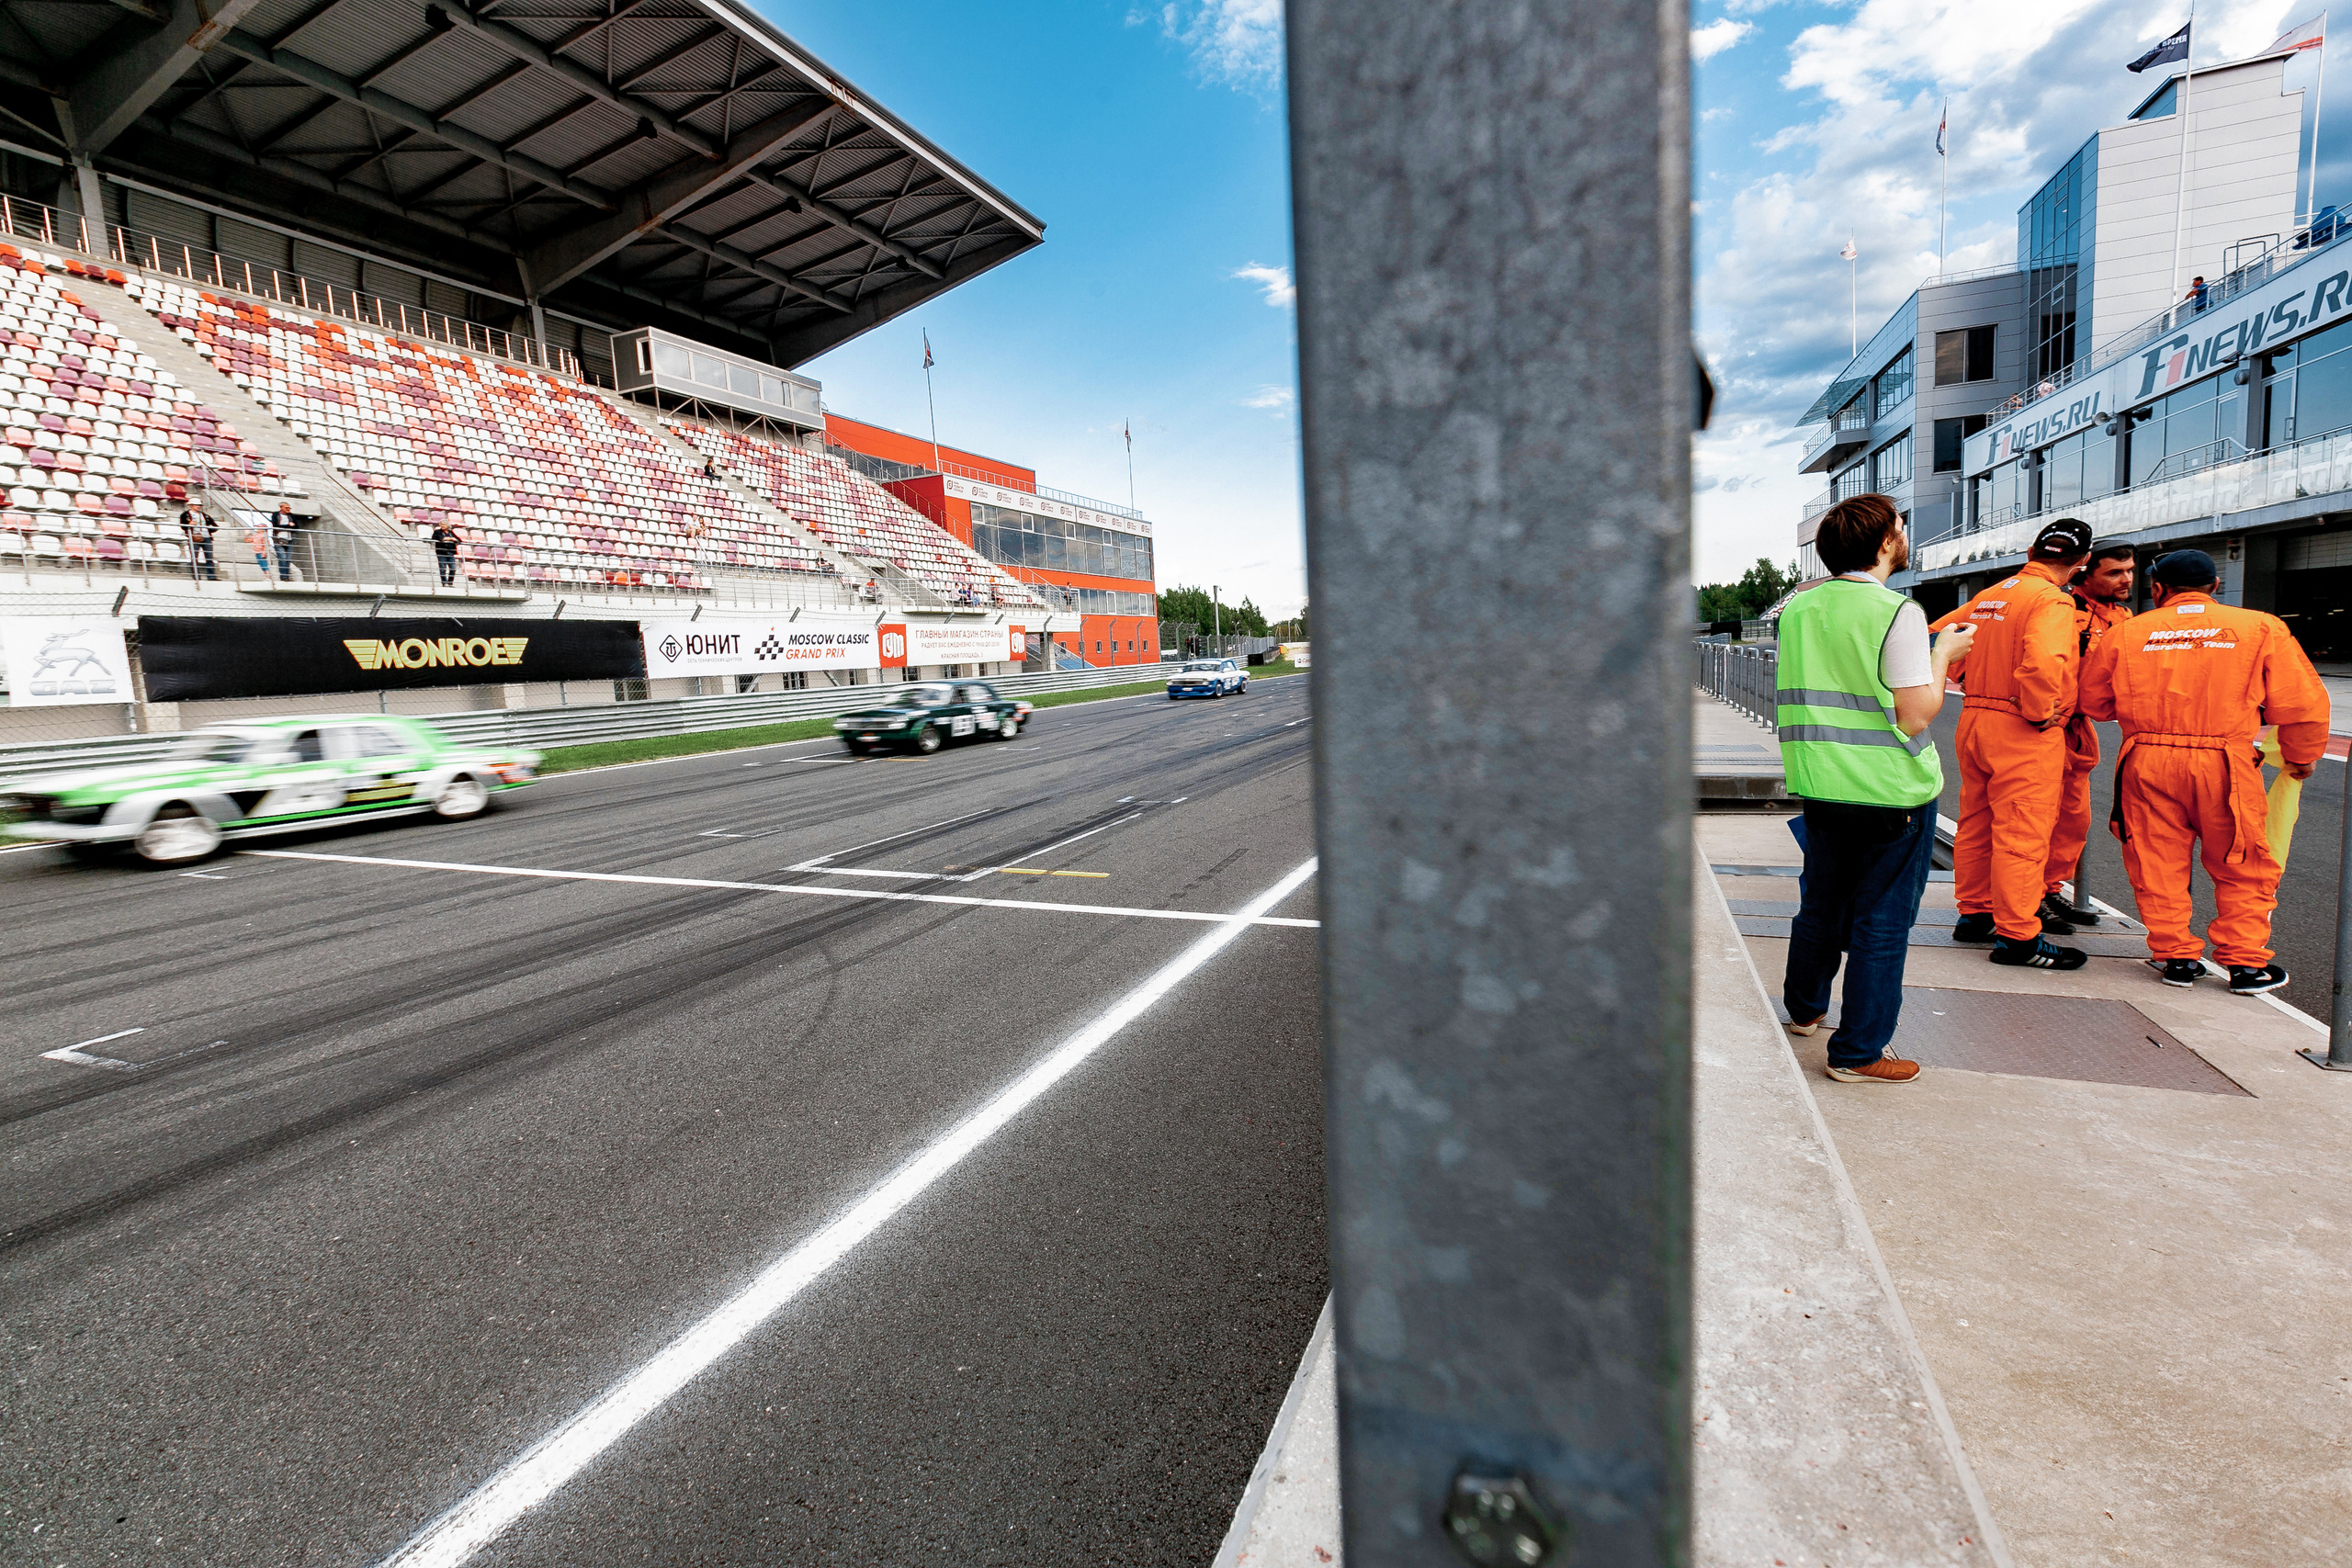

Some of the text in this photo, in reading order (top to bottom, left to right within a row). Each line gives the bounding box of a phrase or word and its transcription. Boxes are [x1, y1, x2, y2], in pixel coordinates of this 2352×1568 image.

[2134, 270, 2352, 400] F1NEWS.R
[1985, 391, 2100, 466] F1NEWS.RU
[788, 634, 870, 645] MOSCOW CLASSIC
[915, 628, 1003, 639] ГЛАВНЫЙ МАГАЗИН СТРАНЫ
[2149, 628, 2222, 640] MOSCOW
[686, 634, 741, 655] ЮНИТ
[2143, 641, 2235, 652] Marshals Team
[373, 637, 510, 670] MONROE
[786, 648, 845, 660] GRAND PRIX
[29, 680, 117, 695] GAZ
